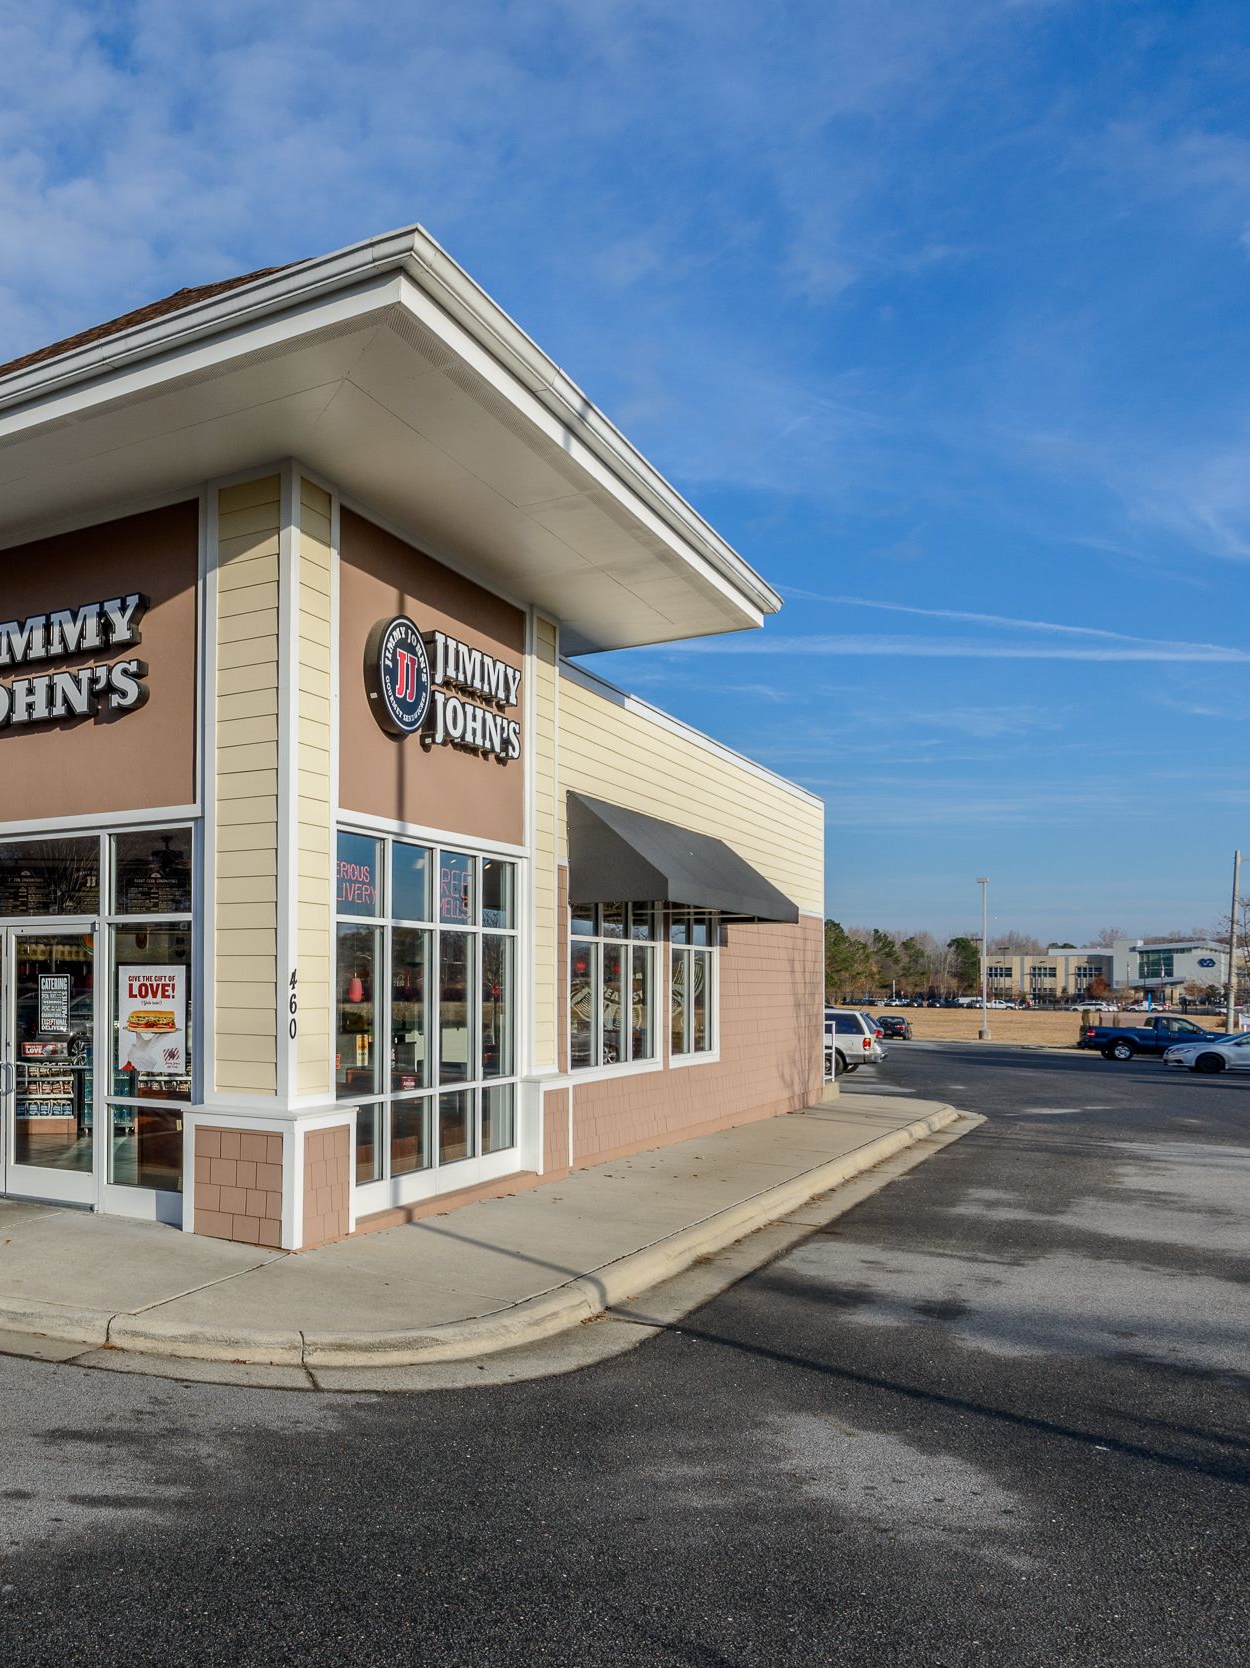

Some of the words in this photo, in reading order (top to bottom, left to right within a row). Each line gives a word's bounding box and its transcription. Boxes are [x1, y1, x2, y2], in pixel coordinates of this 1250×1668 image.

[384, 626, 406, 668] JIMMY
[407, 629, 428, 684] JOHN'S
[395, 648, 418, 703] JJ
[434, 631, 521, 706] JIMMY
[385, 675, 403, 718] GOURMET
[434, 690, 521, 759] JOHN'S
[41, 977, 68, 991] CATERING
[128, 983, 176, 999] LOVE!
[289, 968, 298, 1040] 460
